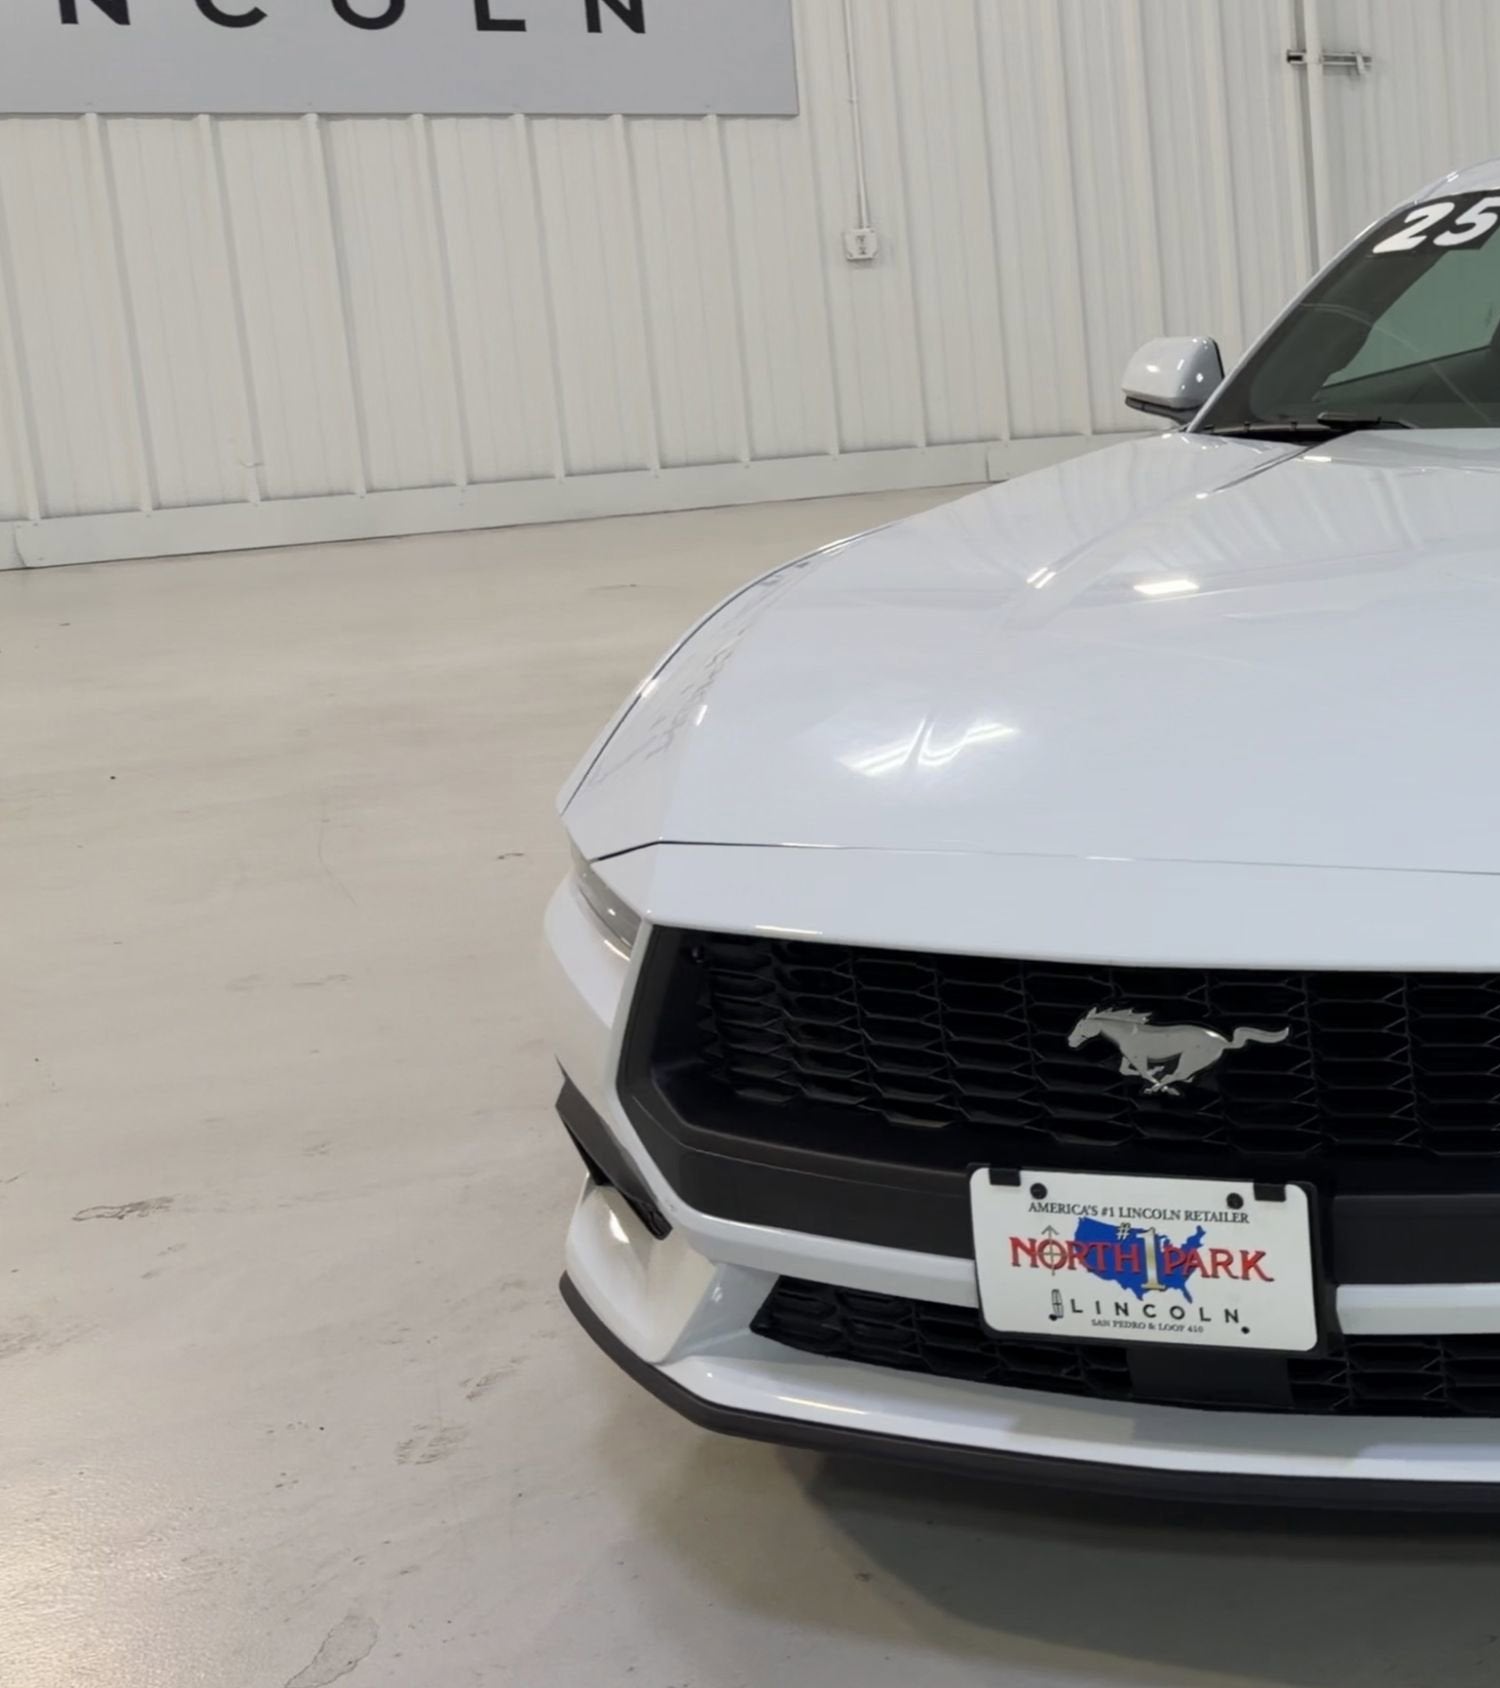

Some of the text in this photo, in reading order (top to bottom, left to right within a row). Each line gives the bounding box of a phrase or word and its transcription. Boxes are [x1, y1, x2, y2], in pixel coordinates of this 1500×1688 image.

[1028, 1202, 1250, 1224] AMERICA'S #1 LINCOLN RETAILER
[1009, 1236, 1275, 1282] NORTH PARK
[1070, 1298, 1240, 1324] LINCOLN
[1112, 1320, 1146, 1330] PEDRO
